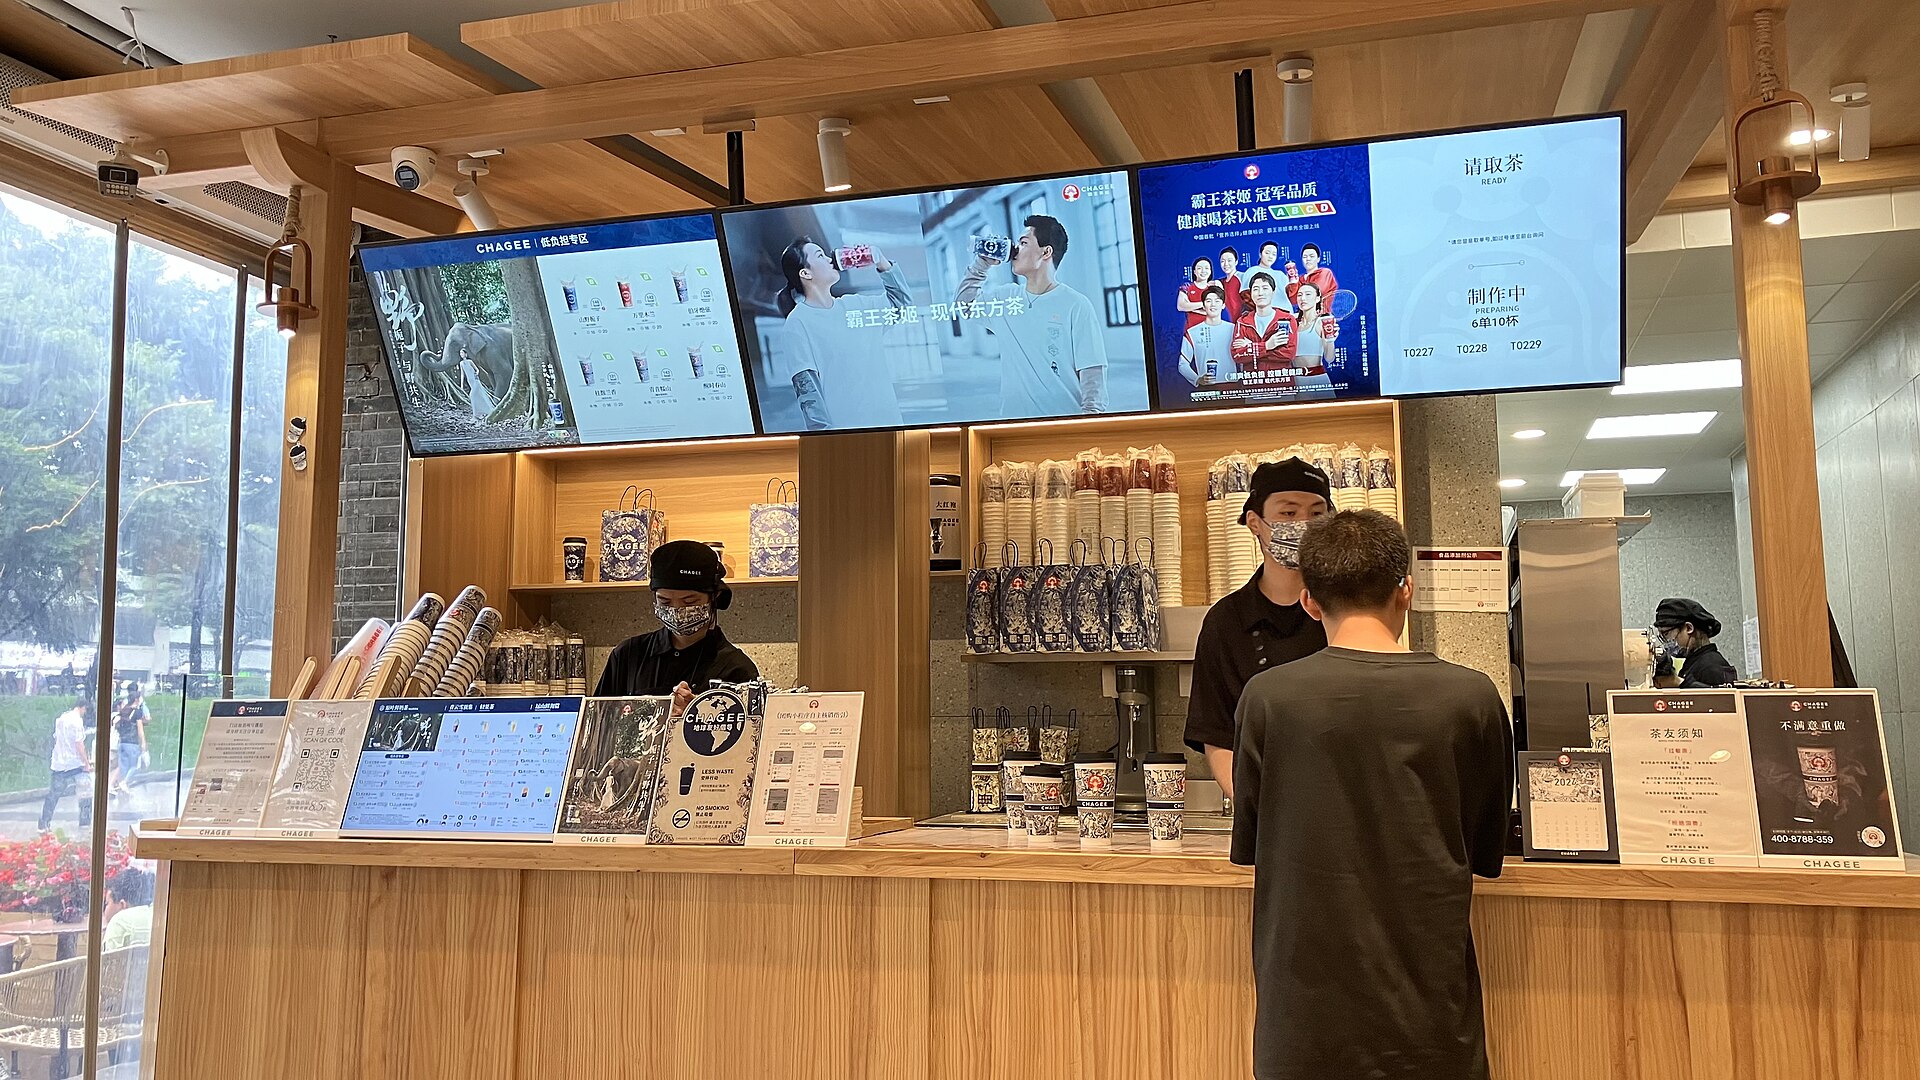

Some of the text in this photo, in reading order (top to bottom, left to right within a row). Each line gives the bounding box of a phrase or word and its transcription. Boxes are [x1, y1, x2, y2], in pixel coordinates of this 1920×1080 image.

[1464, 153, 1524, 176] 请取茶
[1481, 177, 1507, 185] READY
[1190, 181, 1318, 210] 霸王茶姬 冠军品质
[1177, 206, 1268, 231] 健康喝茶认准
[540, 233, 589, 248] 低负担专区
[476, 239, 531, 254] CHAGEE
[1468, 285, 1525, 305] 制作中
[845, 296, 1025, 328] 霸王茶姬 现代东方茶
[1475, 305, 1520, 314] PREPARING
[1471, 315, 1519, 329] 6单10杯
[1404, 339, 1542, 358] T0227 T0228 T0229
[753, 536, 798, 545] CHAGEE
[603, 542, 646, 551] CHAGEE
[685, 713, 745, 723] CHAGEE
[1780, 720, 1846, 731] 不满意重做
[305, 727, 346, 737] 扫码点单
[1650, 728, 1703, 739] 茶友须知
[1771, 834, 1834, 844] 400-8788-359
[1661, 856, 1715, 865] CHAGEE
[1803, 859, 1861, 869] CHAGEE
